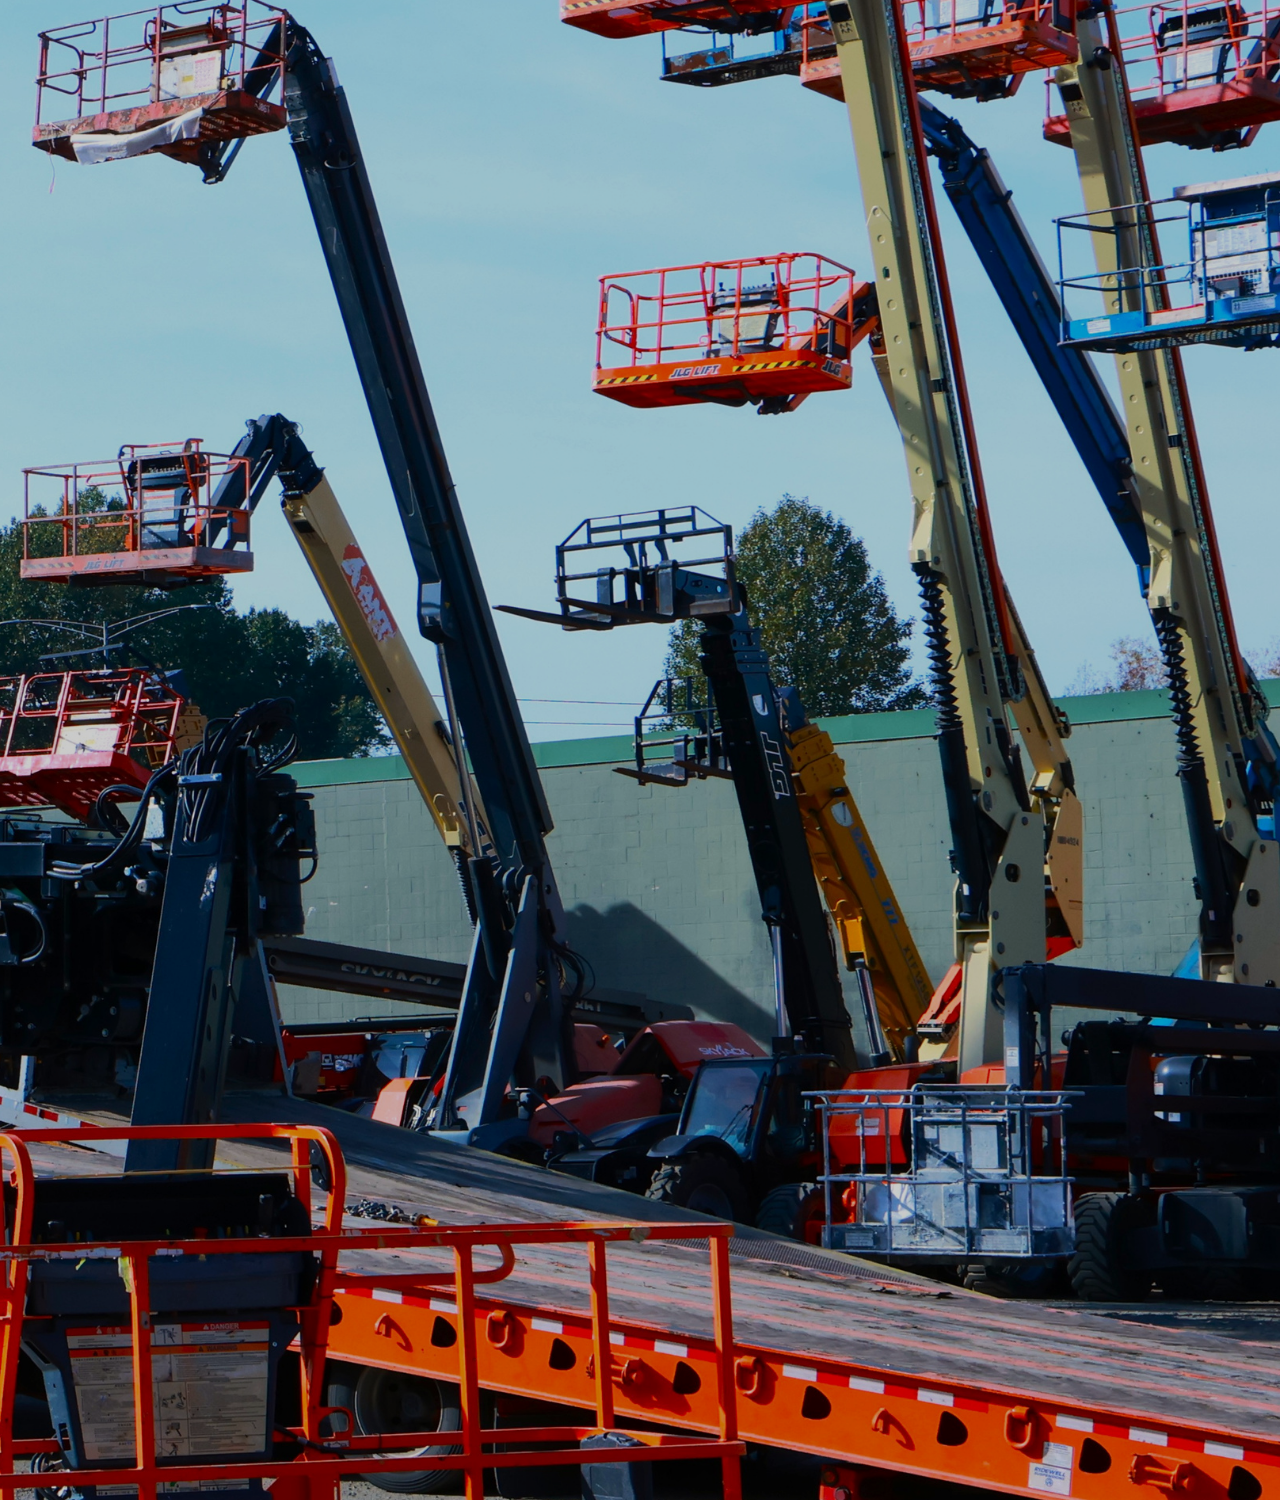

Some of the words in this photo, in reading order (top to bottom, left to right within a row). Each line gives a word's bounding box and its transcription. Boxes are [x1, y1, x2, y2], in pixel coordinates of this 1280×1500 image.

[669, 367, 692, 378] JLG
[693, 364, 720, 377] LIFT
[821, 360, 842, 376] JLG
[760, 731, 791, 799] JLG
[698, 1042, 750, 1057] SKYJACK
[210, 1322, 239, 1331] DANGER
